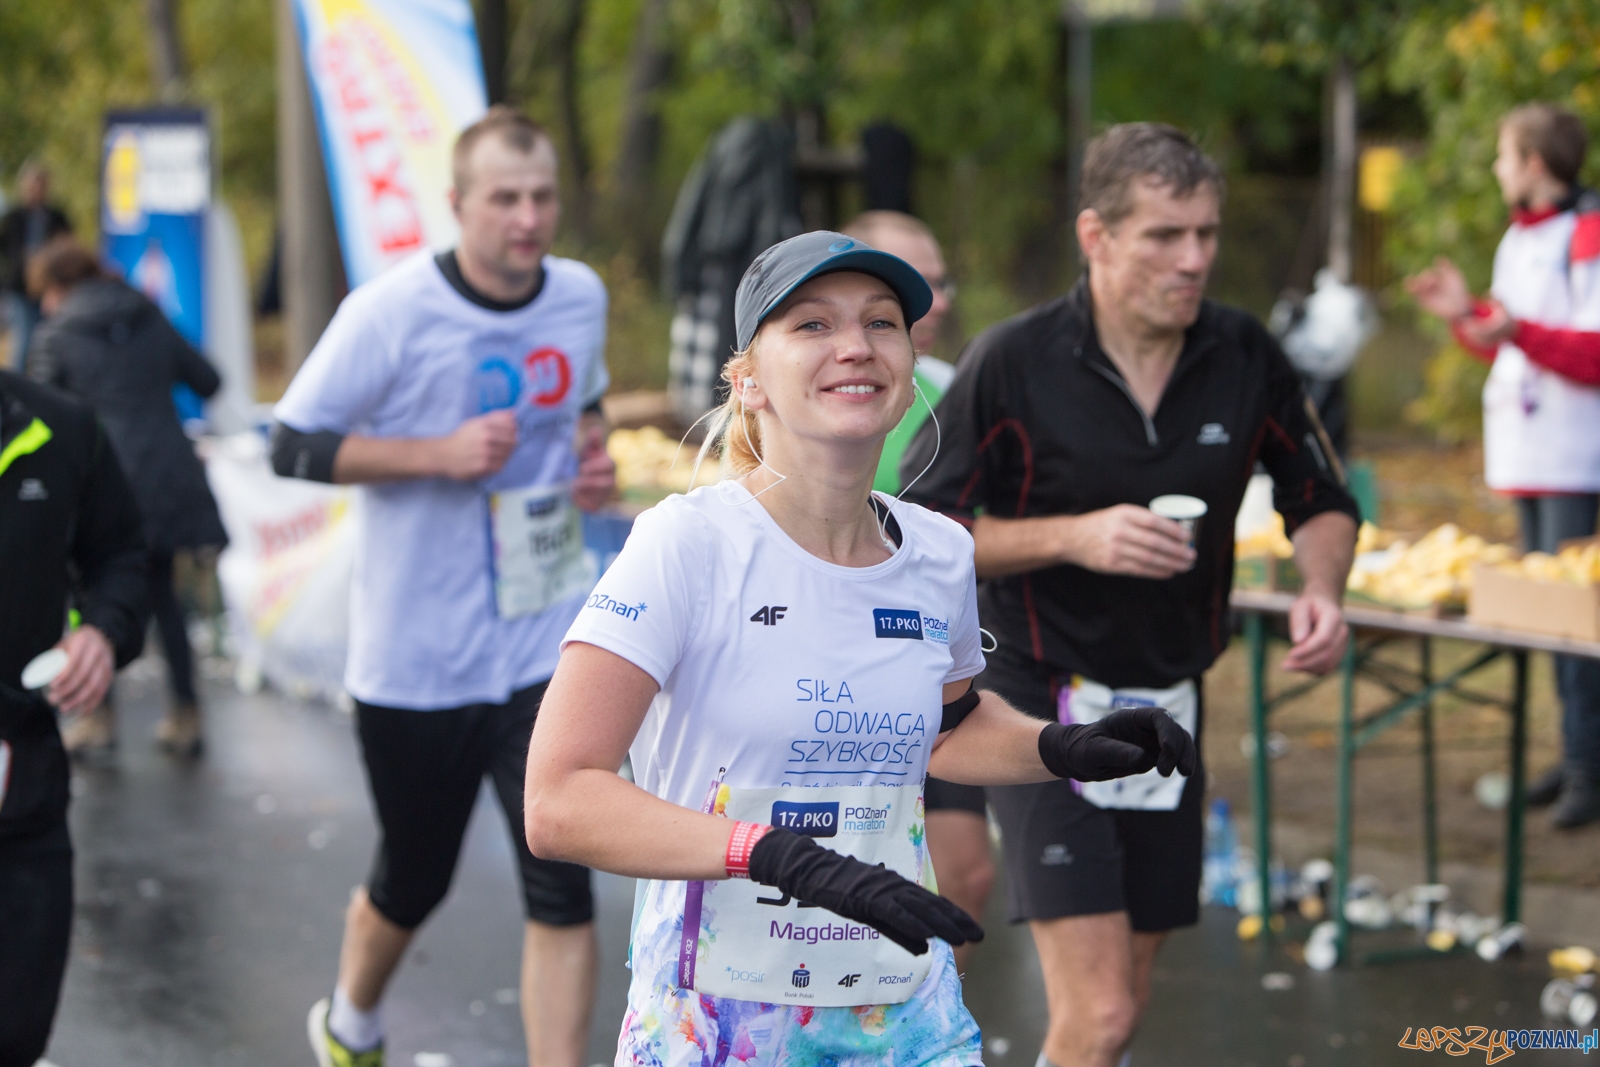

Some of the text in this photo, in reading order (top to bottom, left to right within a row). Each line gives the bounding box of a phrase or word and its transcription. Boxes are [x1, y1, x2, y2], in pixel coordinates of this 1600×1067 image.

[585, 594, 639, 621] OZnan
[750, 605, 788, 626] 4F
[924, 628, 949, 640] marato
[797, 679, 854, 703] SIŁA
[814, 710, 925, 737] ODWAGA
[788, 738, 921, 764] SZYBKOŚĆ
[844, 819, 886, 831] maraton
[770, 920, 880, 945] Magdalena
[838, 974, 862, 988] 4F
